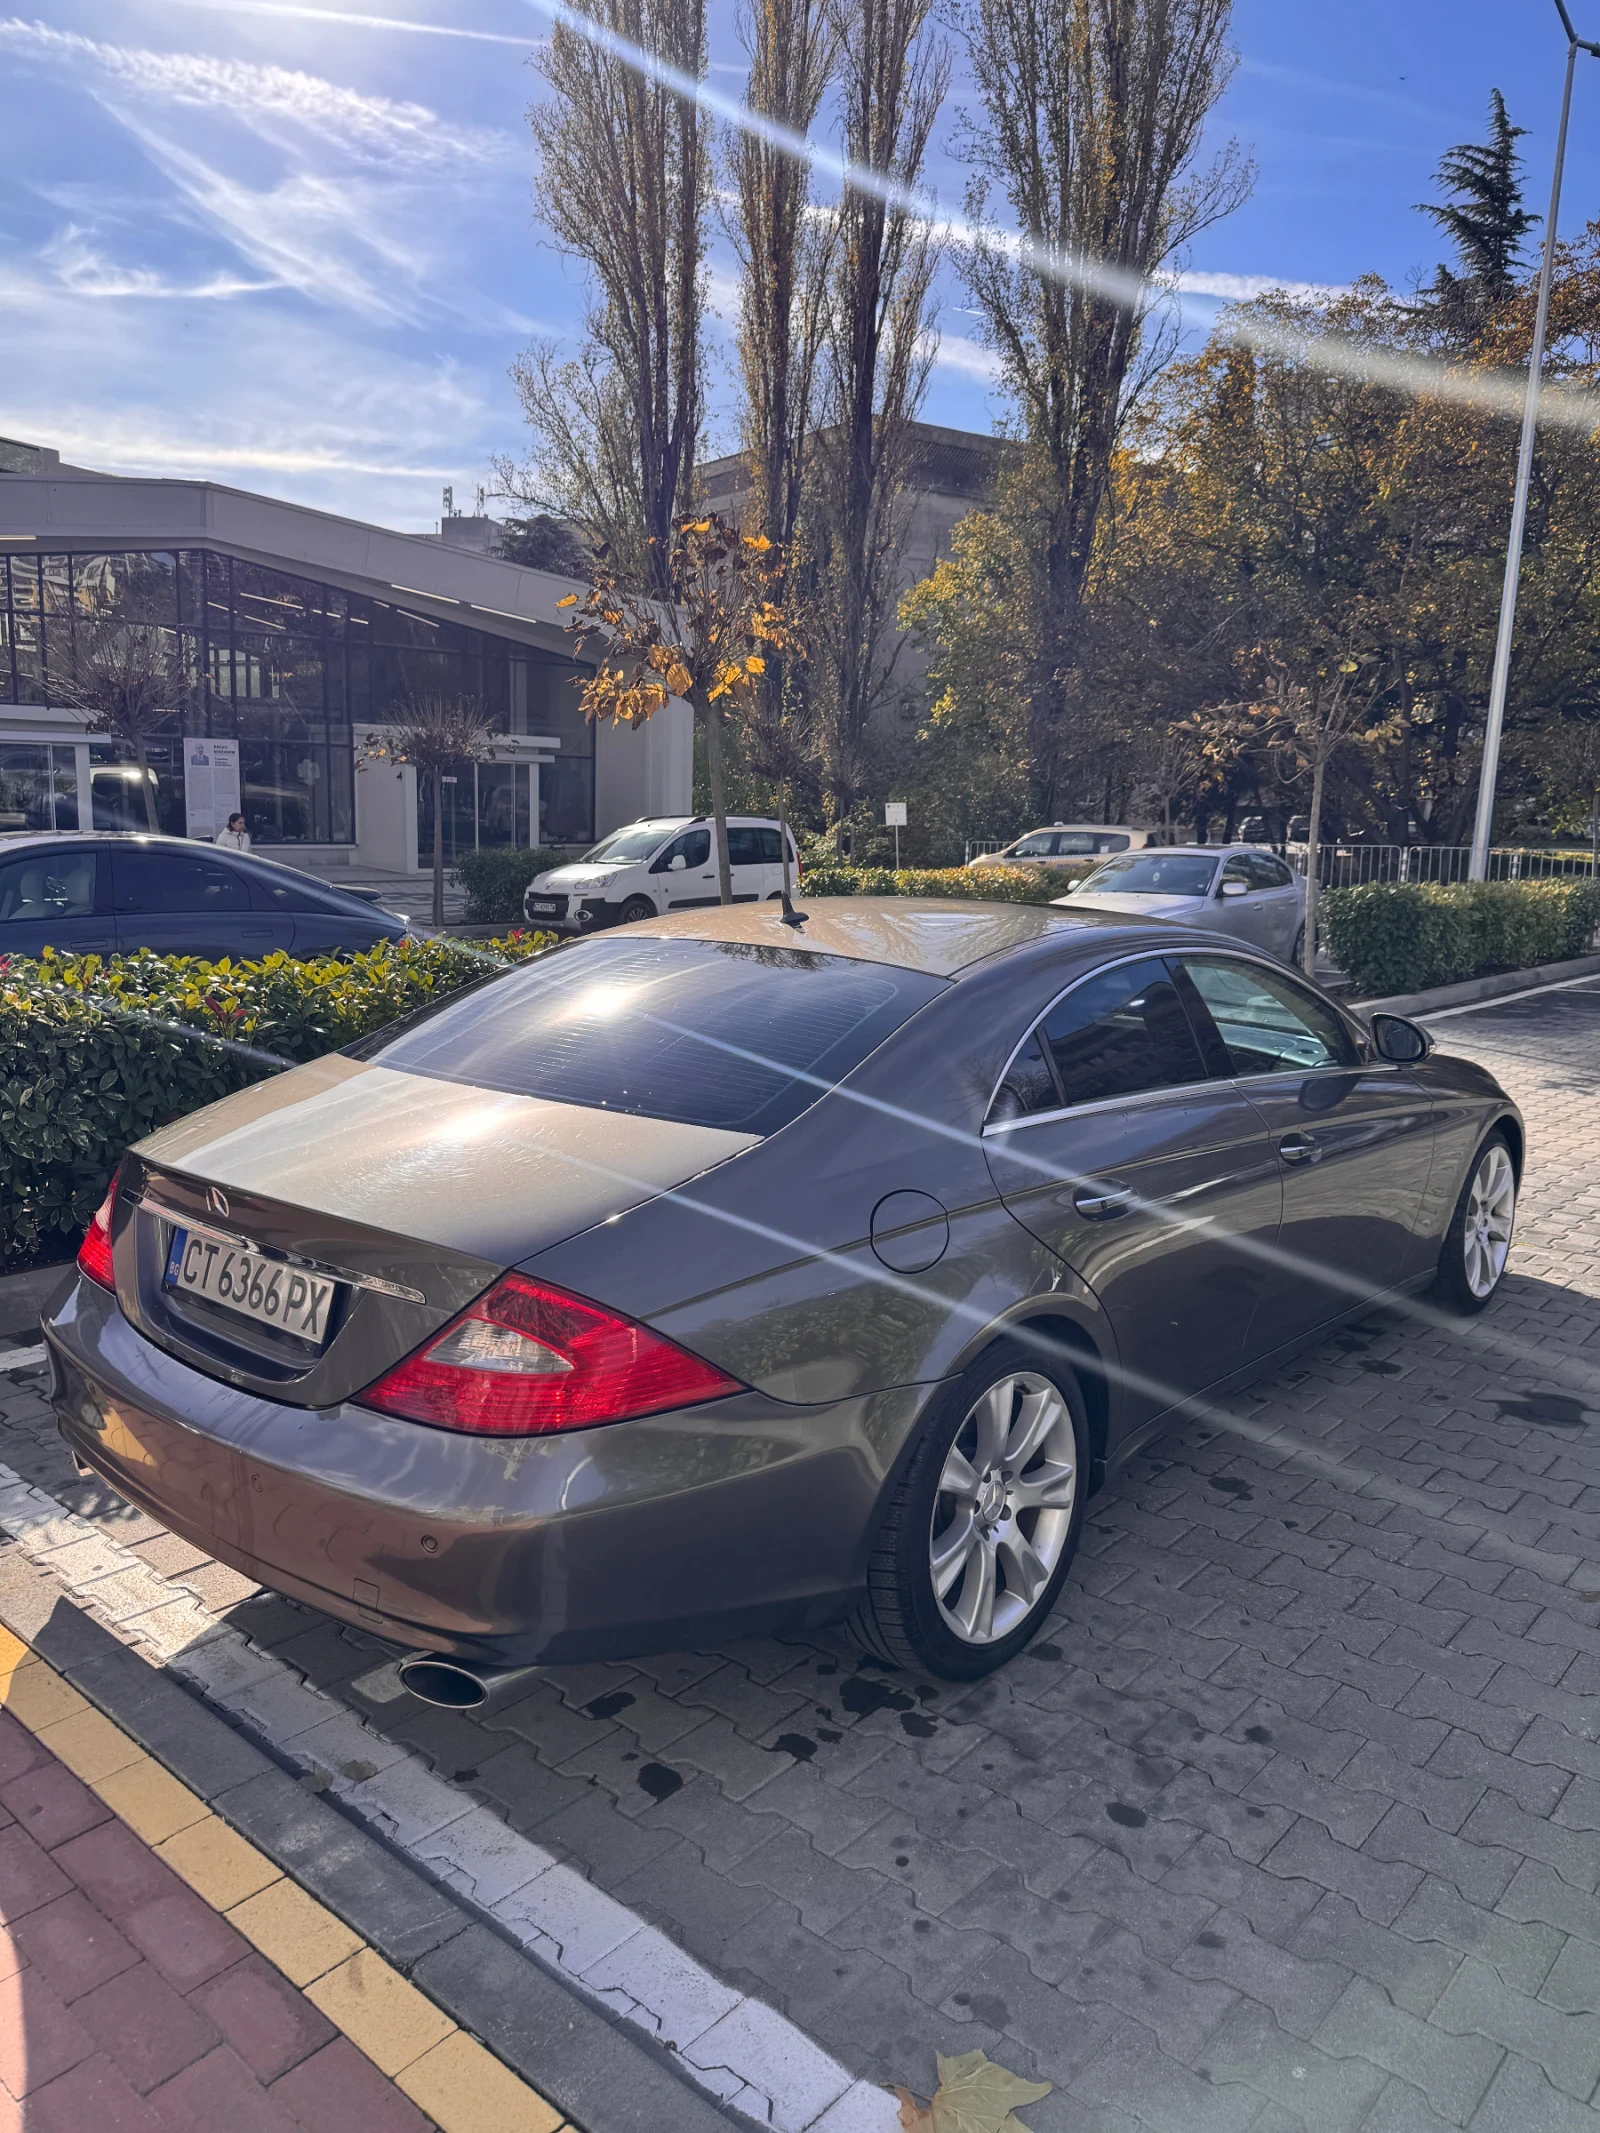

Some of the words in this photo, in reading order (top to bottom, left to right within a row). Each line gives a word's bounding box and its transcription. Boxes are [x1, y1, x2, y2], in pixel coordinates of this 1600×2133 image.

[169, 1261, 180, 1276] BG
[183, 1239, 221, 1289] CT
[218, 1252, 283, 1316] 6366
[283, 1275, 329, 1335] PX
